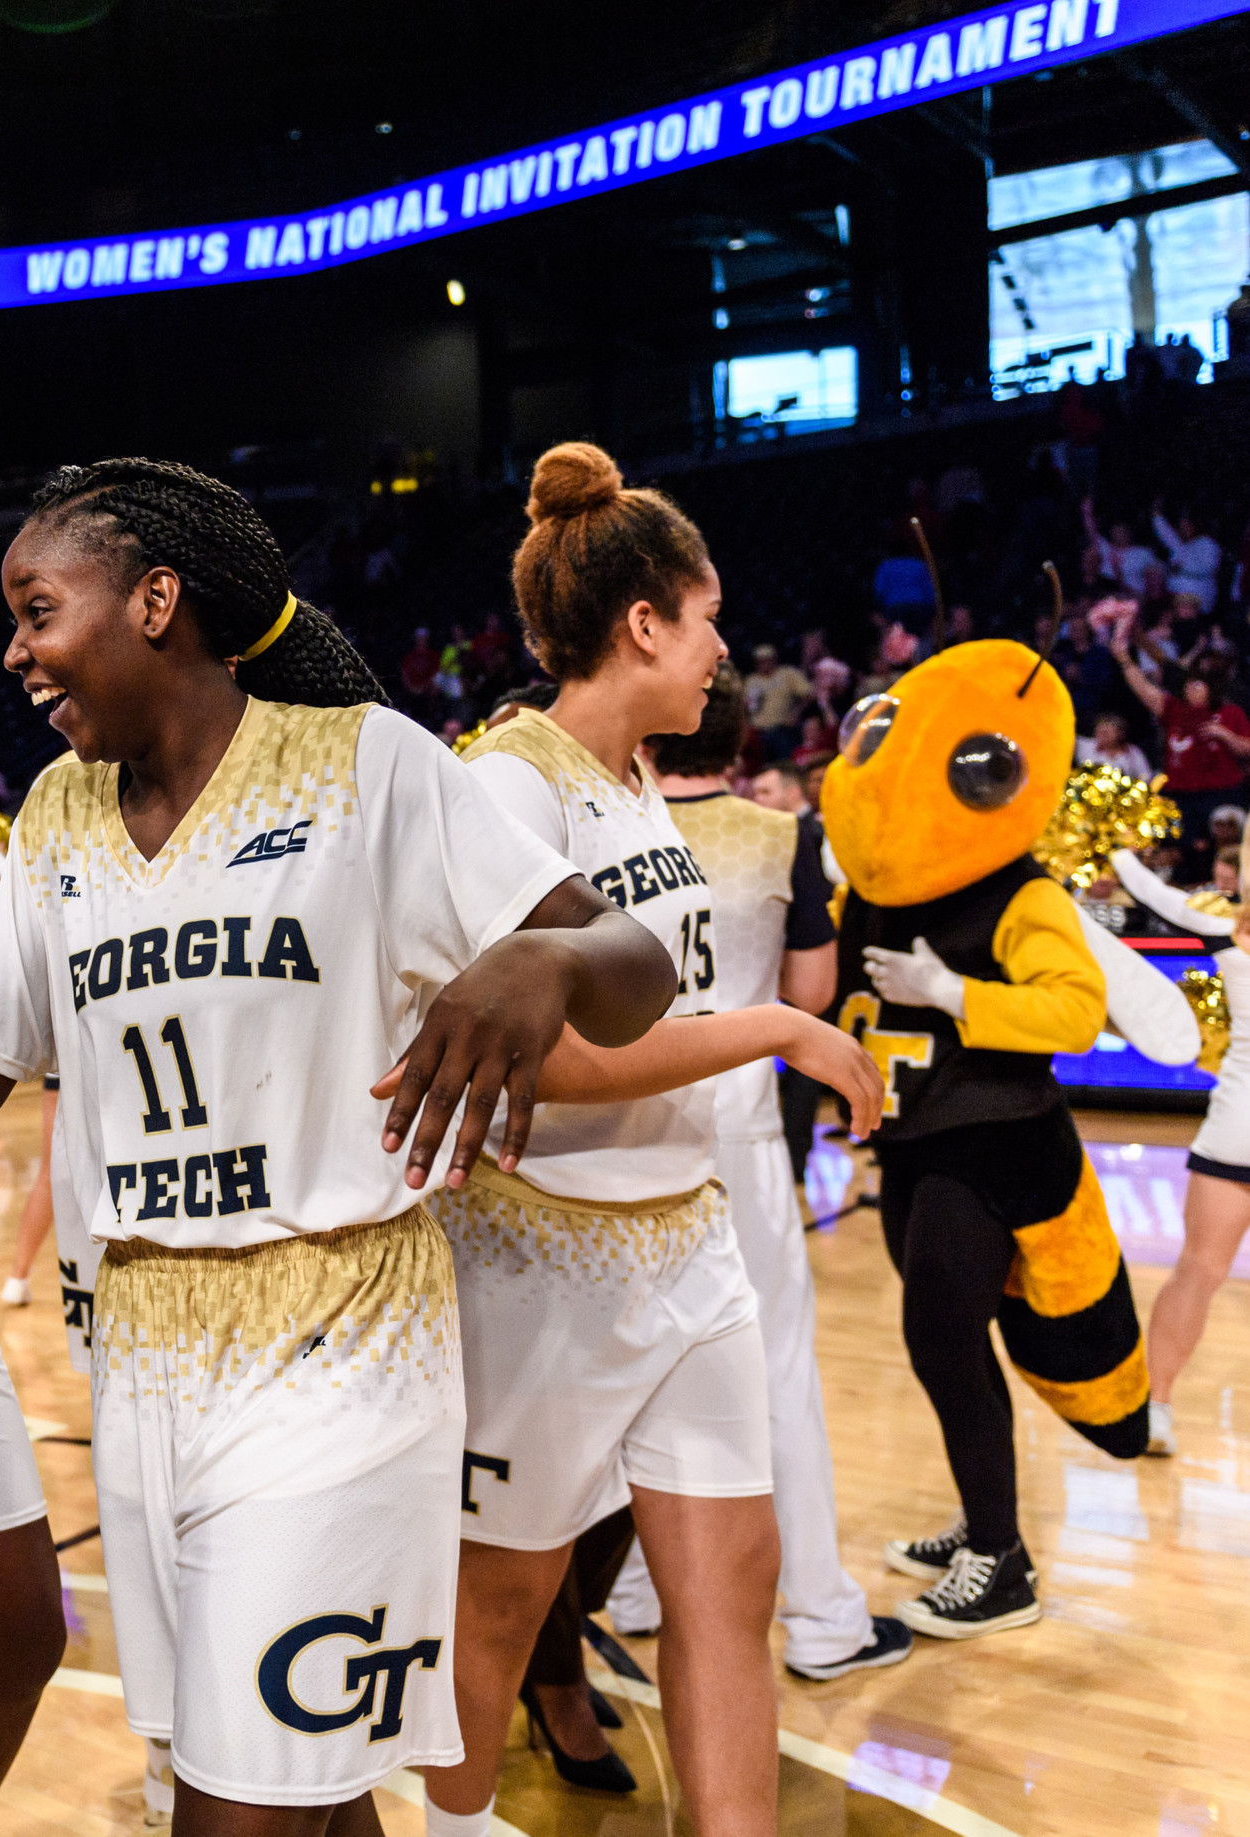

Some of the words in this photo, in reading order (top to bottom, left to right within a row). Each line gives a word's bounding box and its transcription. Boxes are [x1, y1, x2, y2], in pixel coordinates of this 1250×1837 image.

[26, 232, 229, 294] WOMEN'S
[244, 183, 448, 270] NATIONAL
[461, 100, 722, 218] INVITATION
[740, 0, 1119, 137] TOURNAMENT
[225, 820, 313, 868] ACC
[678, 908, 715, 996] 15
[121, 1013, 209, 1137] 11
[106, 1143, 272, 1224] TECH
[254, 1602, 444, 1747] GT
